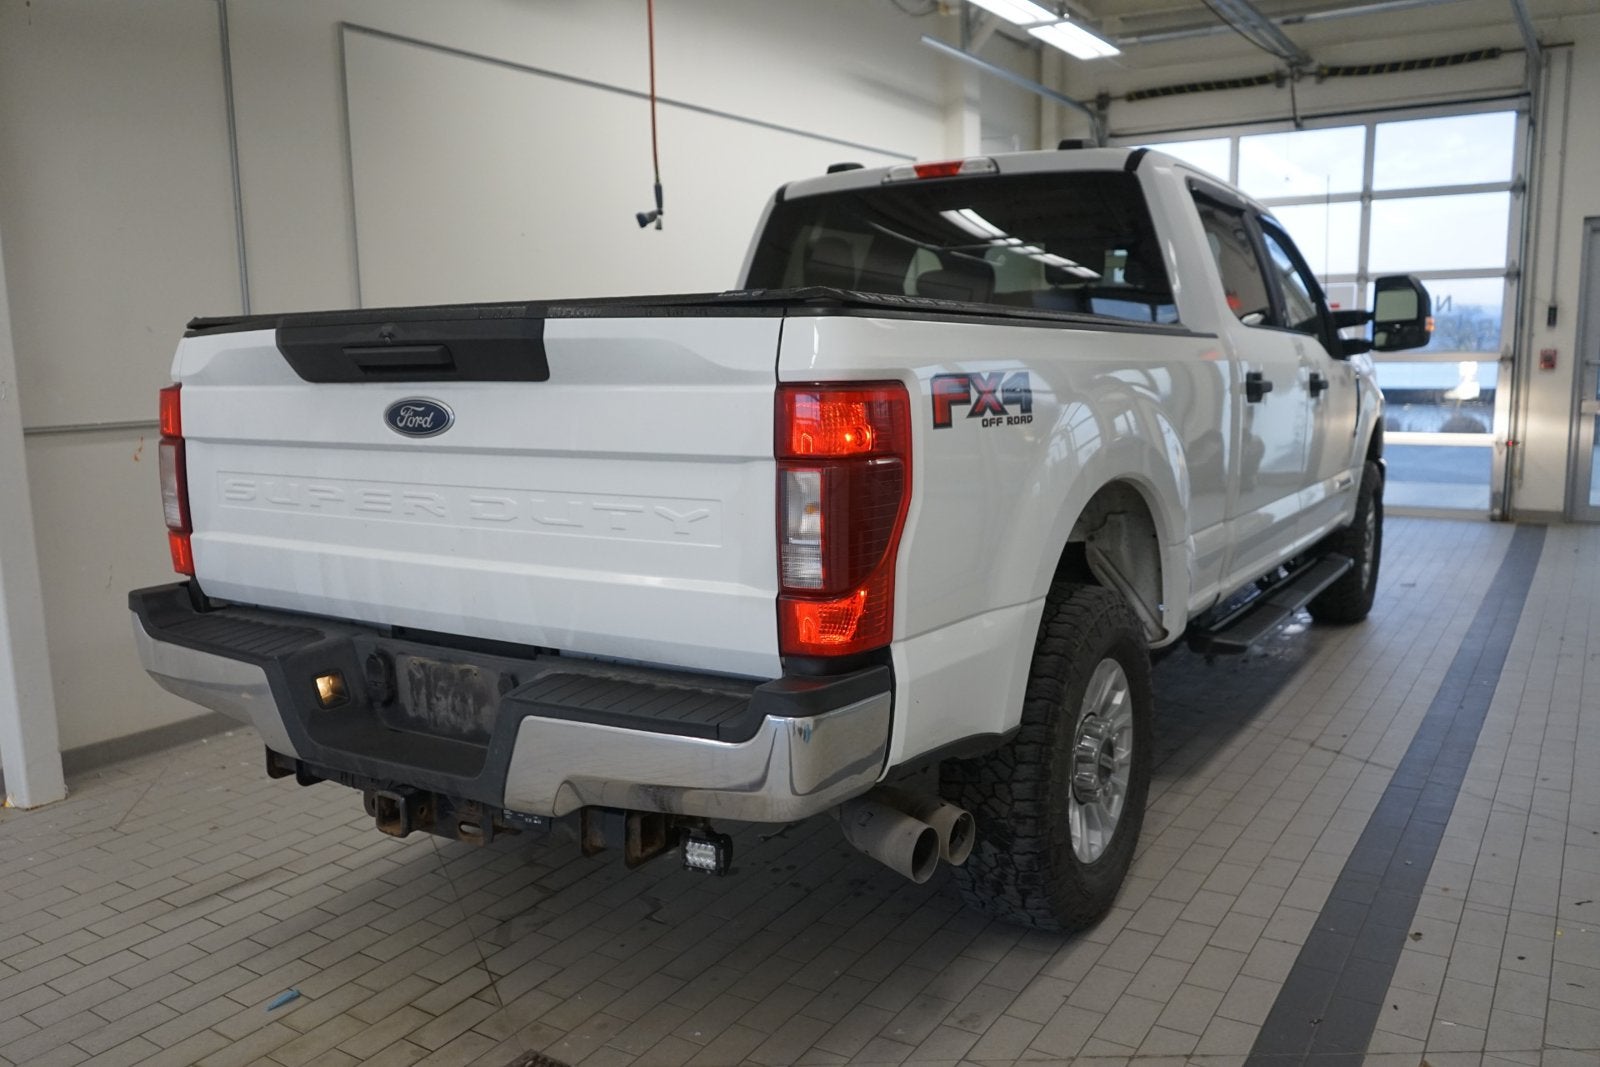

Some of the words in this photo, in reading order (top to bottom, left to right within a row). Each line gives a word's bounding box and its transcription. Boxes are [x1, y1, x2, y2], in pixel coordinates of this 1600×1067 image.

[396, 405, 435, 428] Ford
[930, 371, 1032, 430] FX4
[981, 417, 1004, 428] OFF
[1006, 415, 1034, 426] ROAD
[224, 478, 446, 519] SUPER
[469, 494, 710, 535] DUTY
